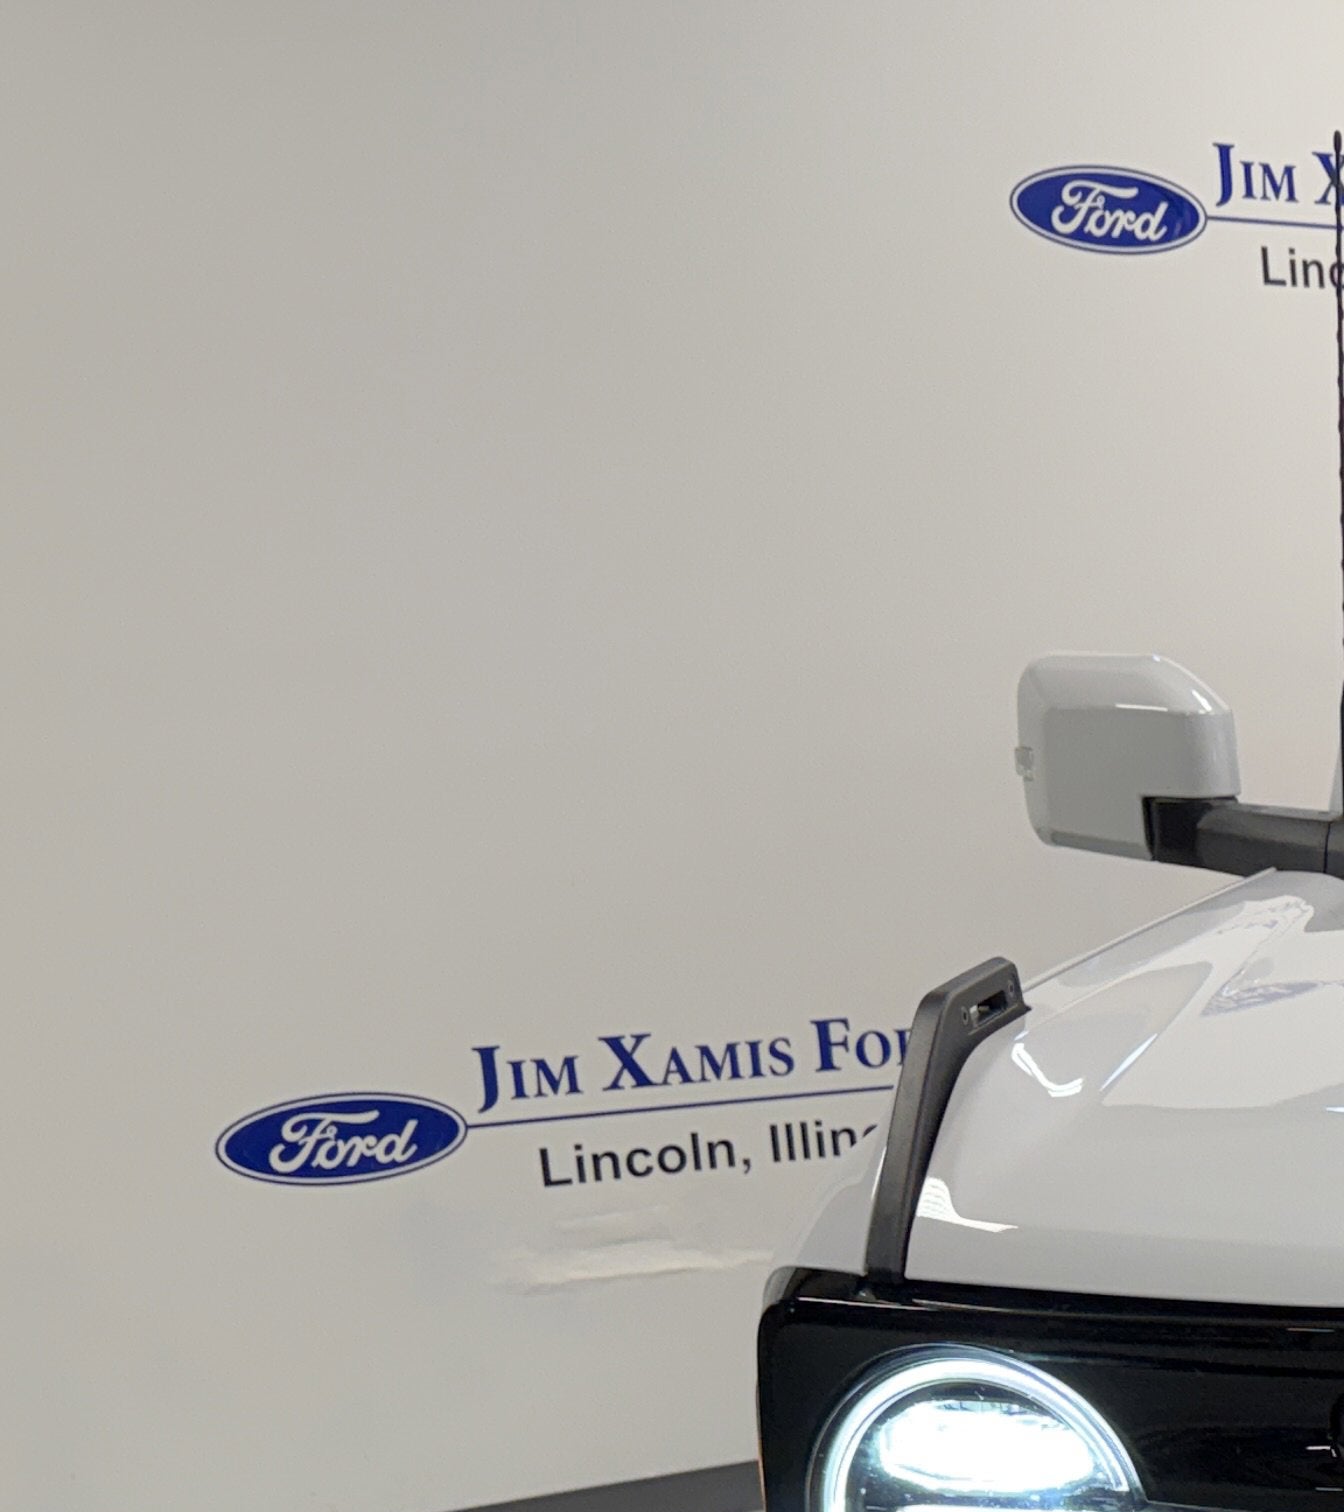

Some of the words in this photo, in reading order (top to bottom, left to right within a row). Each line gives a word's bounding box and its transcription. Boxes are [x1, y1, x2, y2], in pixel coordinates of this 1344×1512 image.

[1212, 142, 1299, 207] JIM
[1050, 179, 1169, 243] Ford
[471, 1045, 583, 1115] JIM
[598, 1033, 796, 1092] XAMIS
[809, 1017, 912, 1072] FO
[269, 1109, 419, 1173] Ford
[539, 1132, 751, 1188] Lincoln,
[769, 1119, 879, 1163] Illin
